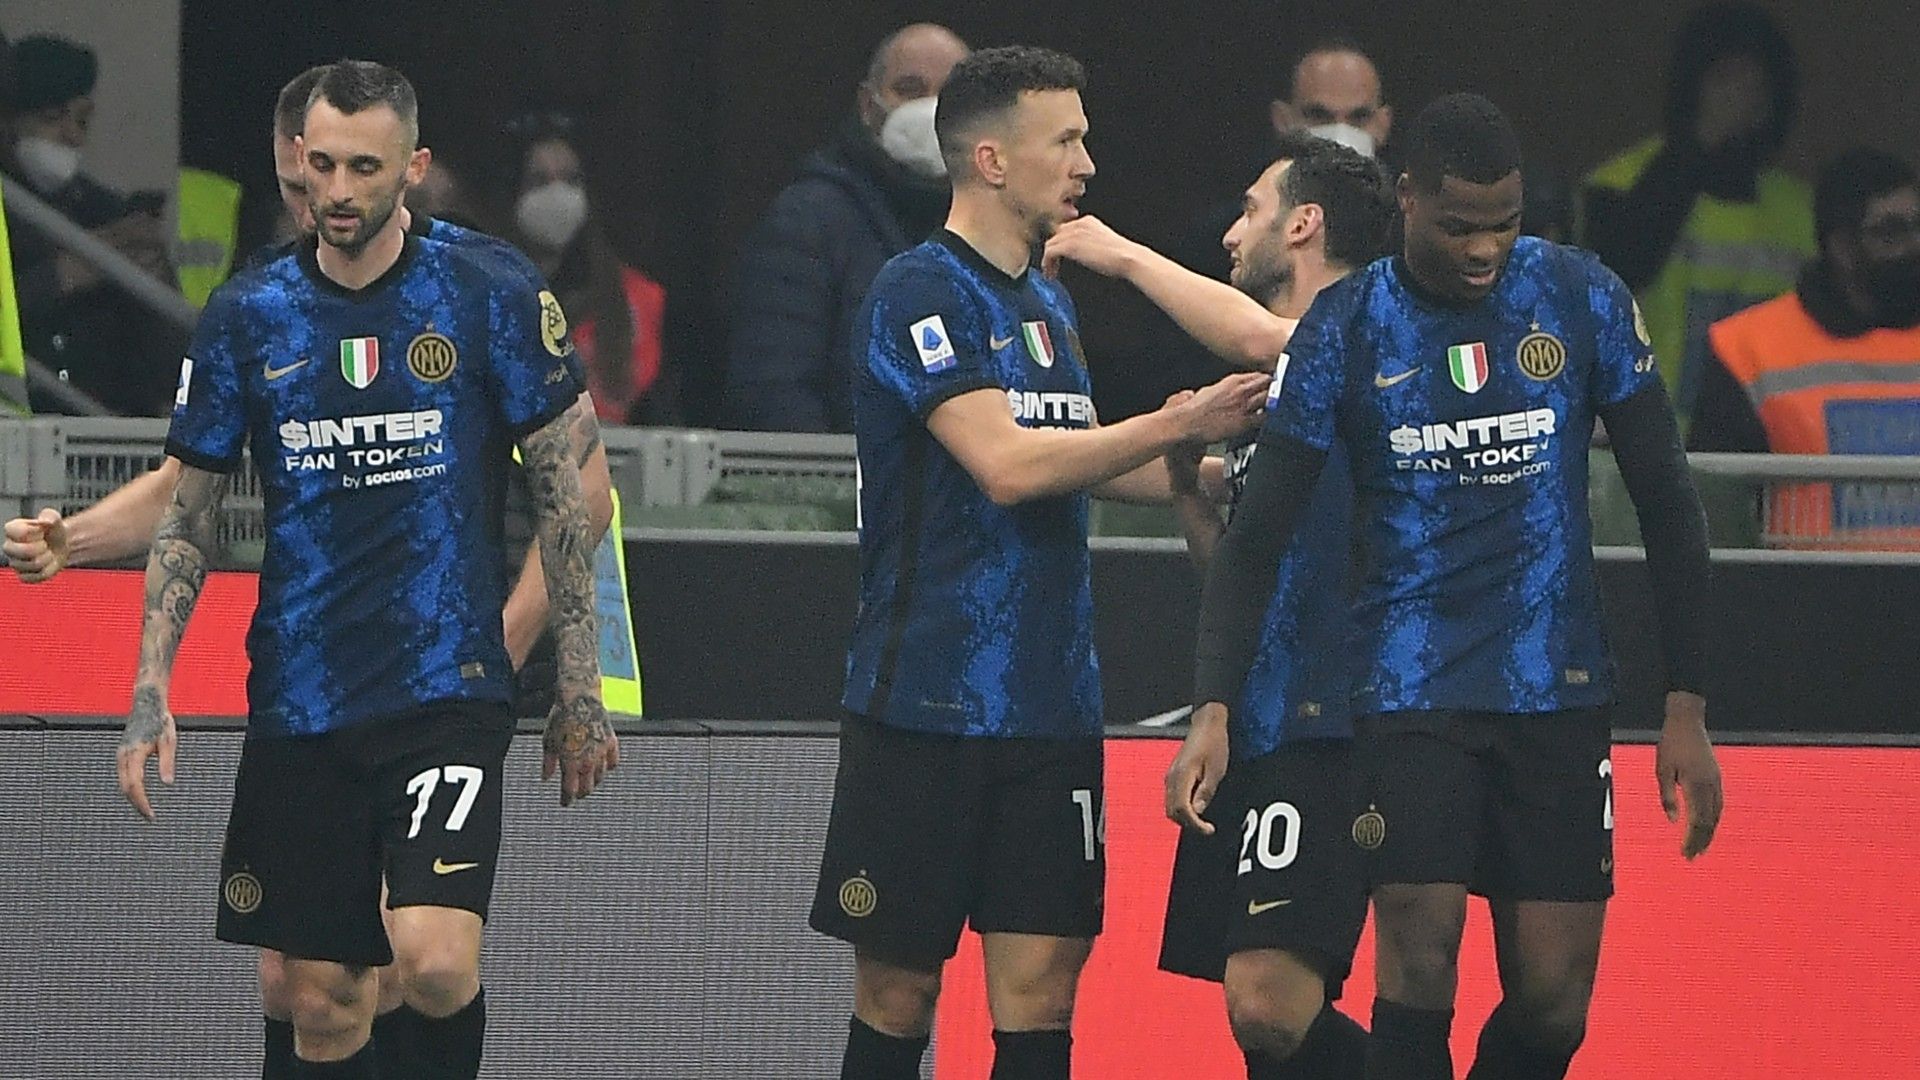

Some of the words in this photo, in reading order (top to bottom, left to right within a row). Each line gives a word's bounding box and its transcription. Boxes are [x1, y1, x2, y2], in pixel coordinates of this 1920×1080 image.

[279, 409, 443, 453] $INTER
[1389, 408, 1556, 456] $INTER
[285, 453, 336, 472] FAN
[347, 439, 443, 467] TOKEN
[342, 474, 361, 488] by
[365, 463, 446, 486] socios.com
[1396, 457, 1452, 472] FAN
[406, 764, 484, 839] 77
[1071, 789, 1105, 861] 1
[1237, 801, 1301, 876] 20
